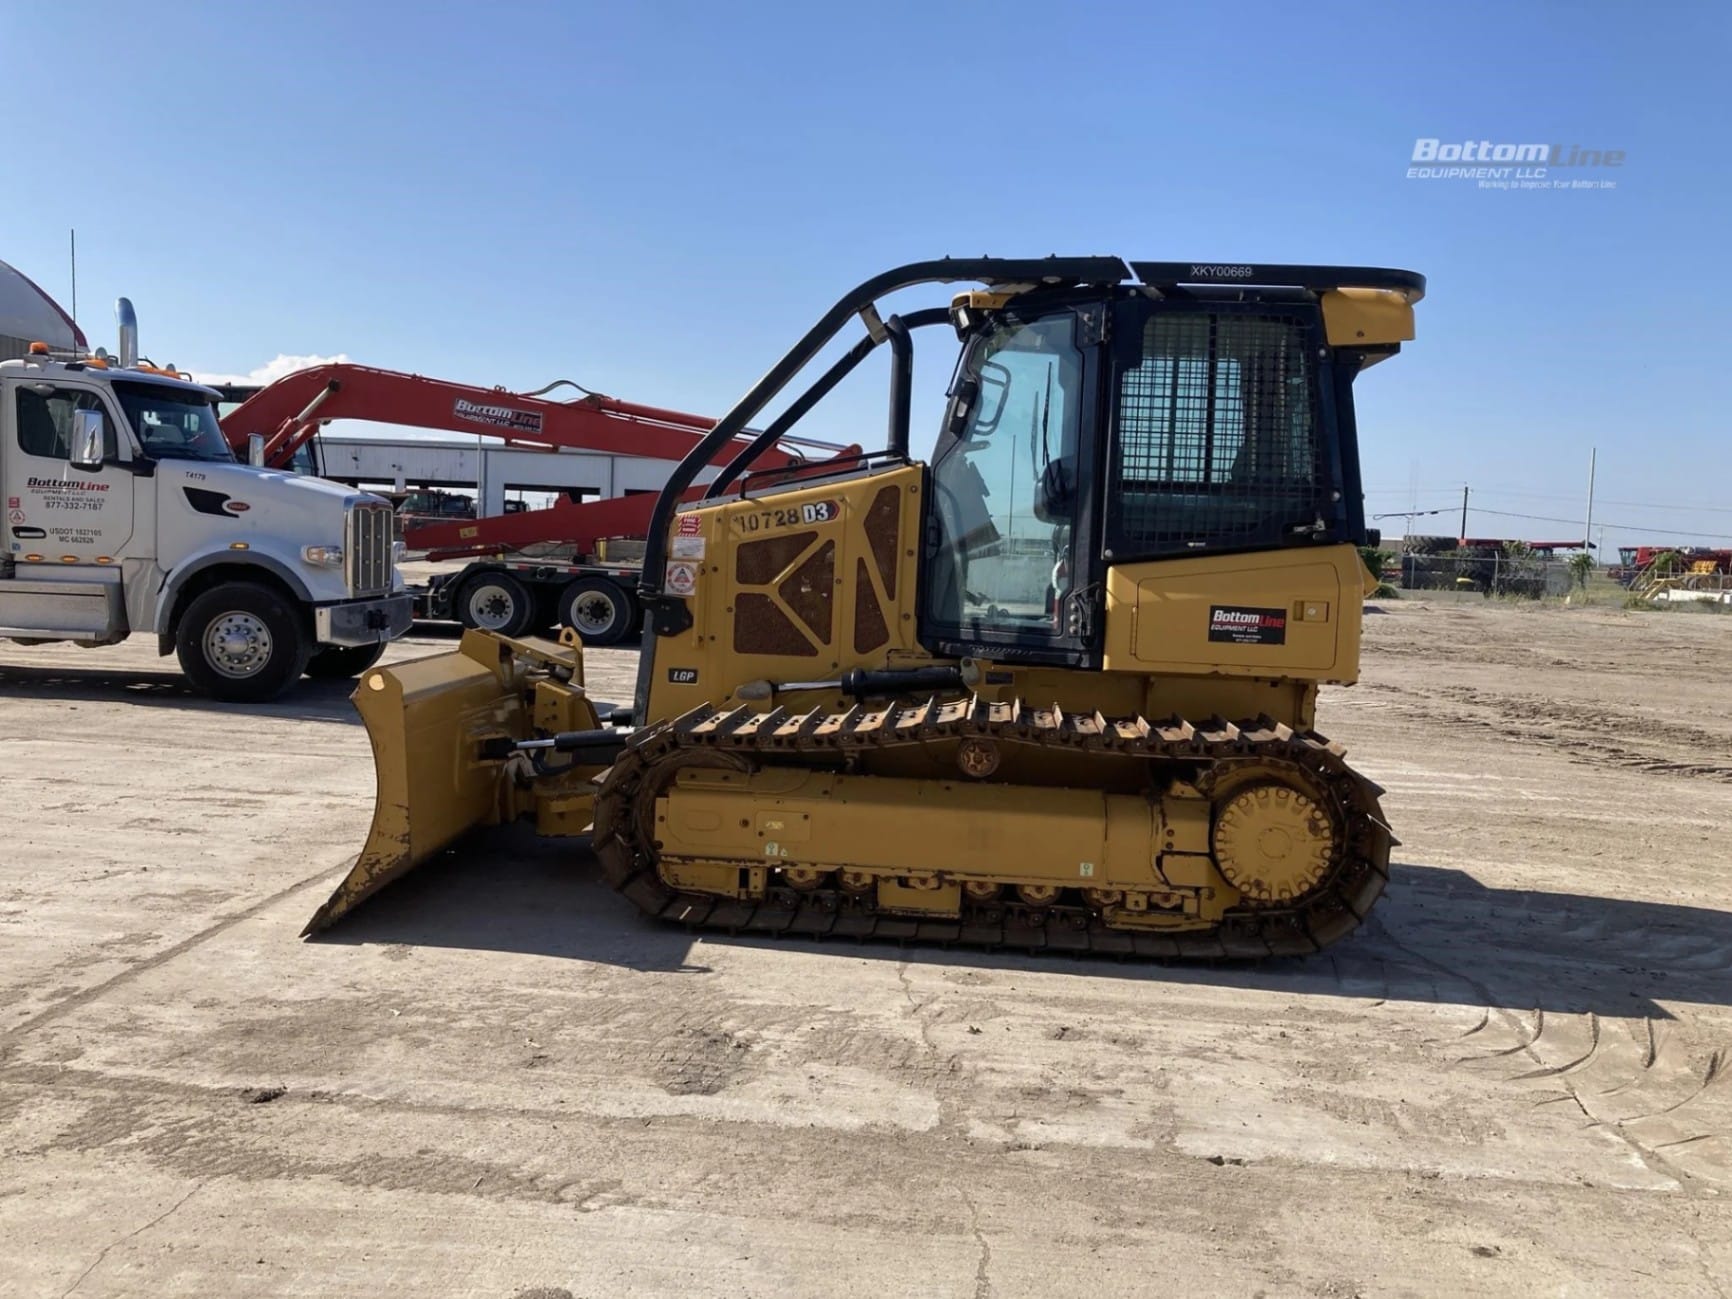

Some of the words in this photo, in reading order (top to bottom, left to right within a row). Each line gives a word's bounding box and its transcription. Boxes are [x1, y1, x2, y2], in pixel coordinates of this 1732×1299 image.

[1191, 265, 1253, 277] XKY00669
[802, 502, 829, 524] D3
[739, 508, 799, 533] 10728
[49, 527, 73, 535] USDOT
[1210, 624, 1246, 632] EQUIPMENT
[1247, 625, 1259, 633] LLC
[673, 671, 695, 681] LGP
